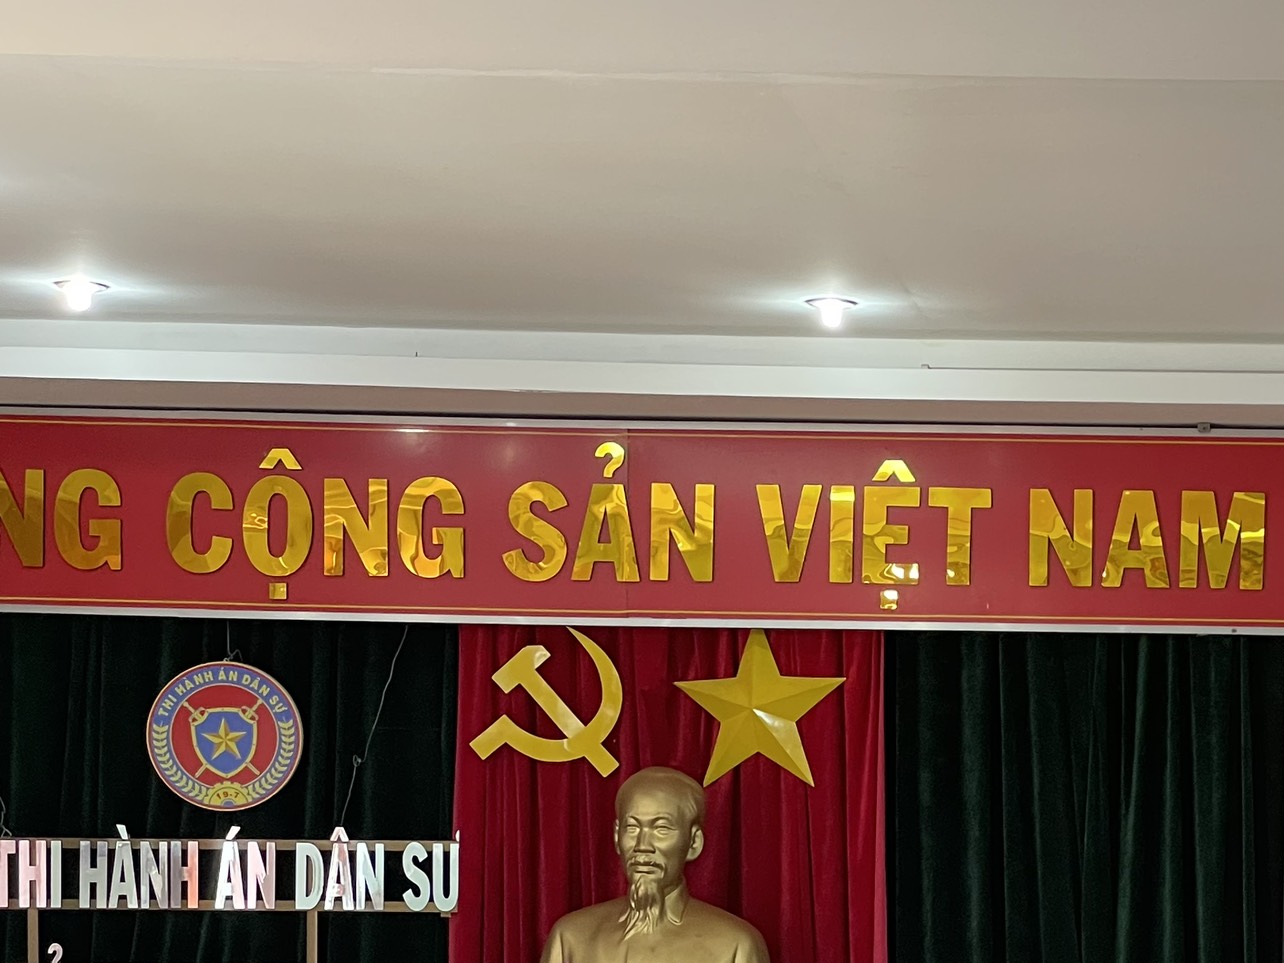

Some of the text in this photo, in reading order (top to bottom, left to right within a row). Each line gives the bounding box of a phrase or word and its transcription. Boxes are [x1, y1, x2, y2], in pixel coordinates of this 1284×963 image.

[0, 467, 123, 572] NG
[165, 447, 467, 600] CỘNG
[501, 442, 716, 584] SẢN
[755, 459, 992, 612] VIỆT
[1028, 487, 1267, 592] NAM
[158, 667, 288, 717] THI HÀNH ÁN DÂN SỰ
[79, 824, 199, 909] HÀNH
[214, 826, 276, 910] ÁN
[295, 826, 385, 911] DÂN
